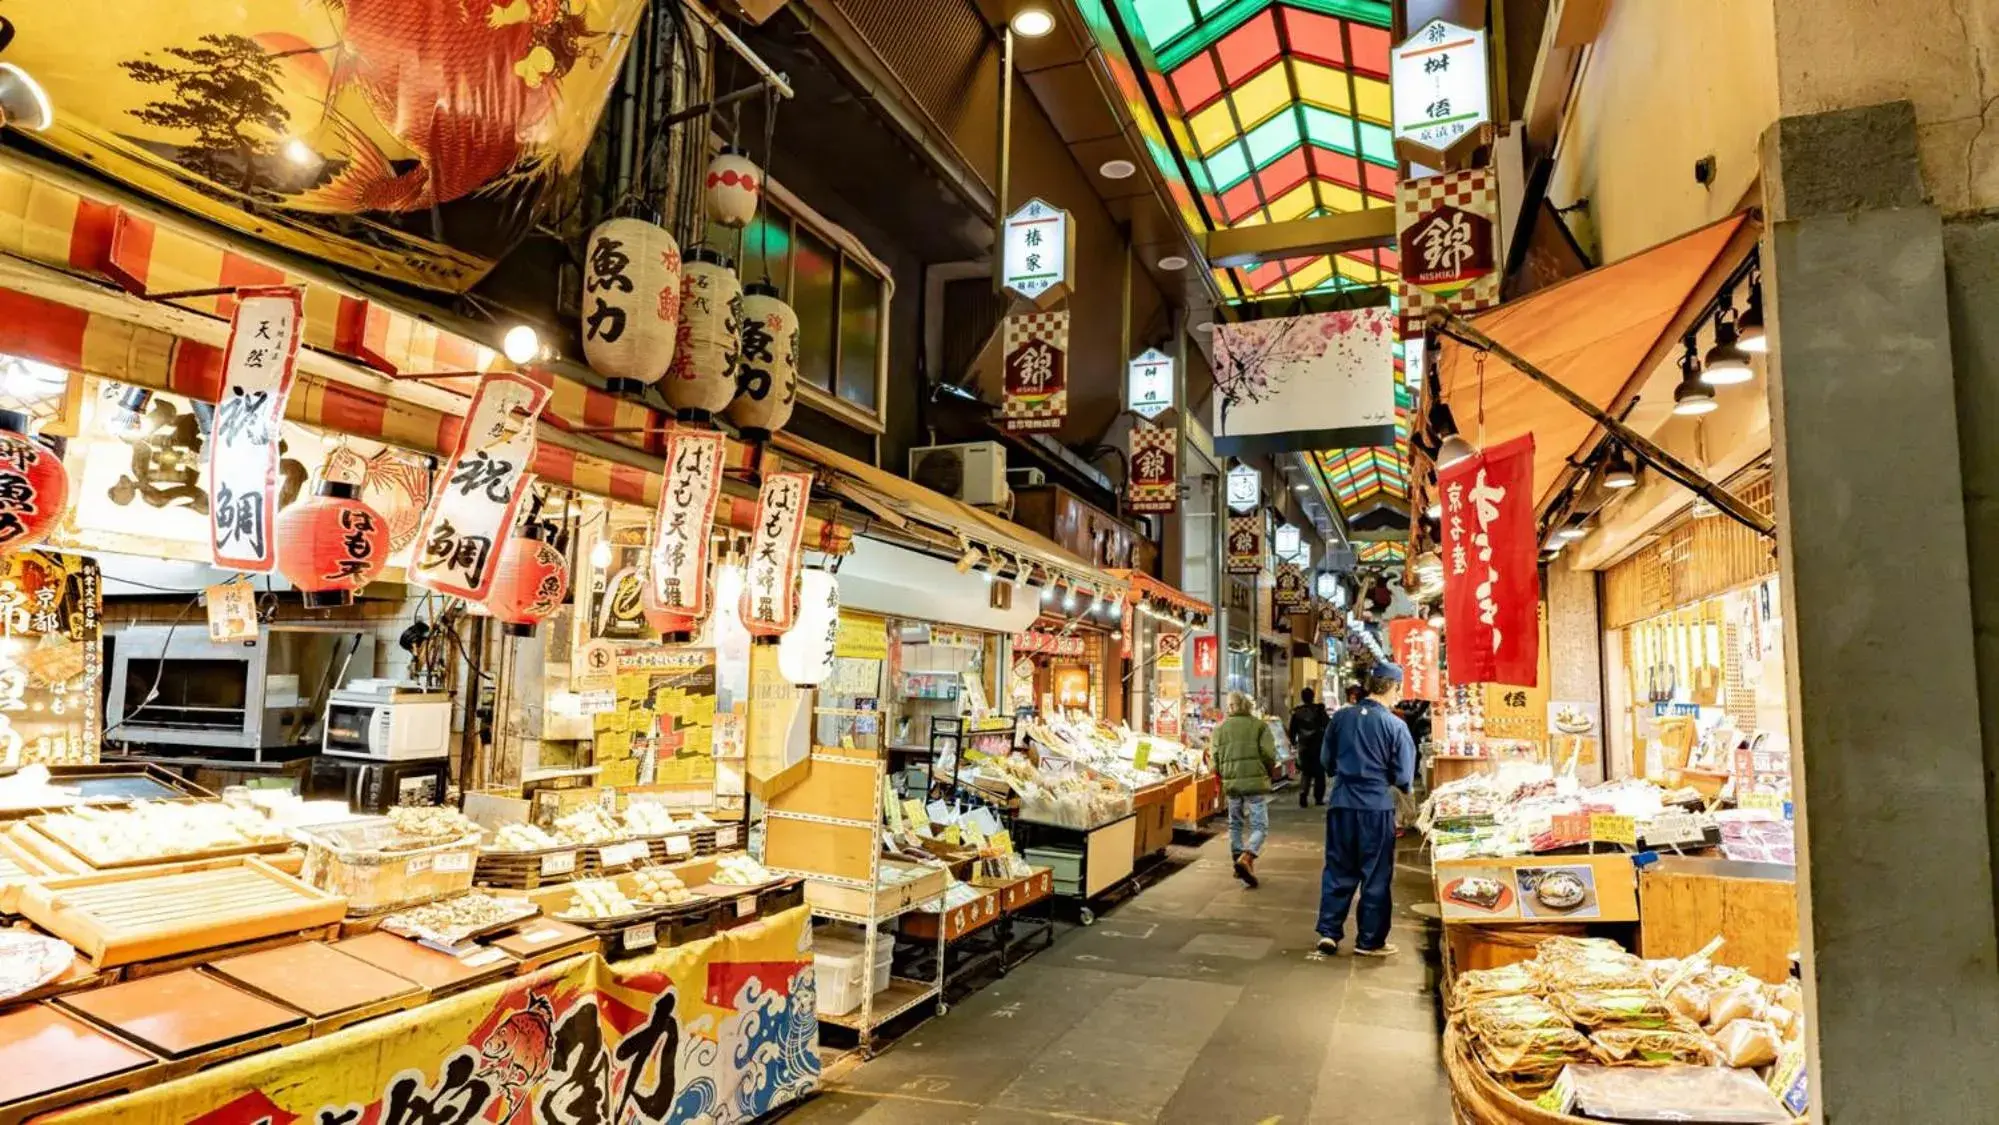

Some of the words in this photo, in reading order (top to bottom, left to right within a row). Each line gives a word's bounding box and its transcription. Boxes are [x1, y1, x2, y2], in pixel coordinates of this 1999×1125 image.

[1025, 228, 1043, 272] 椿家
[1412, 212, 1475, 274] 錦
[587, 237, 634, 343] 魚力
[1419, 269, 1454, 282] NISHIKI
[244, 321, 270, 368] 天然
[734, 318, 774, 401] 魚力
[1013, 344, 1053, 393] 錦
[1136, 449, 1166, 483] 錦
[416, 448, 513, 589] 祝鯛
[663, 446, 702, 607] はも天婦羅
[756, 484, 789, 623] はも天婦羅
[33, 585, 60, 632] 京都
